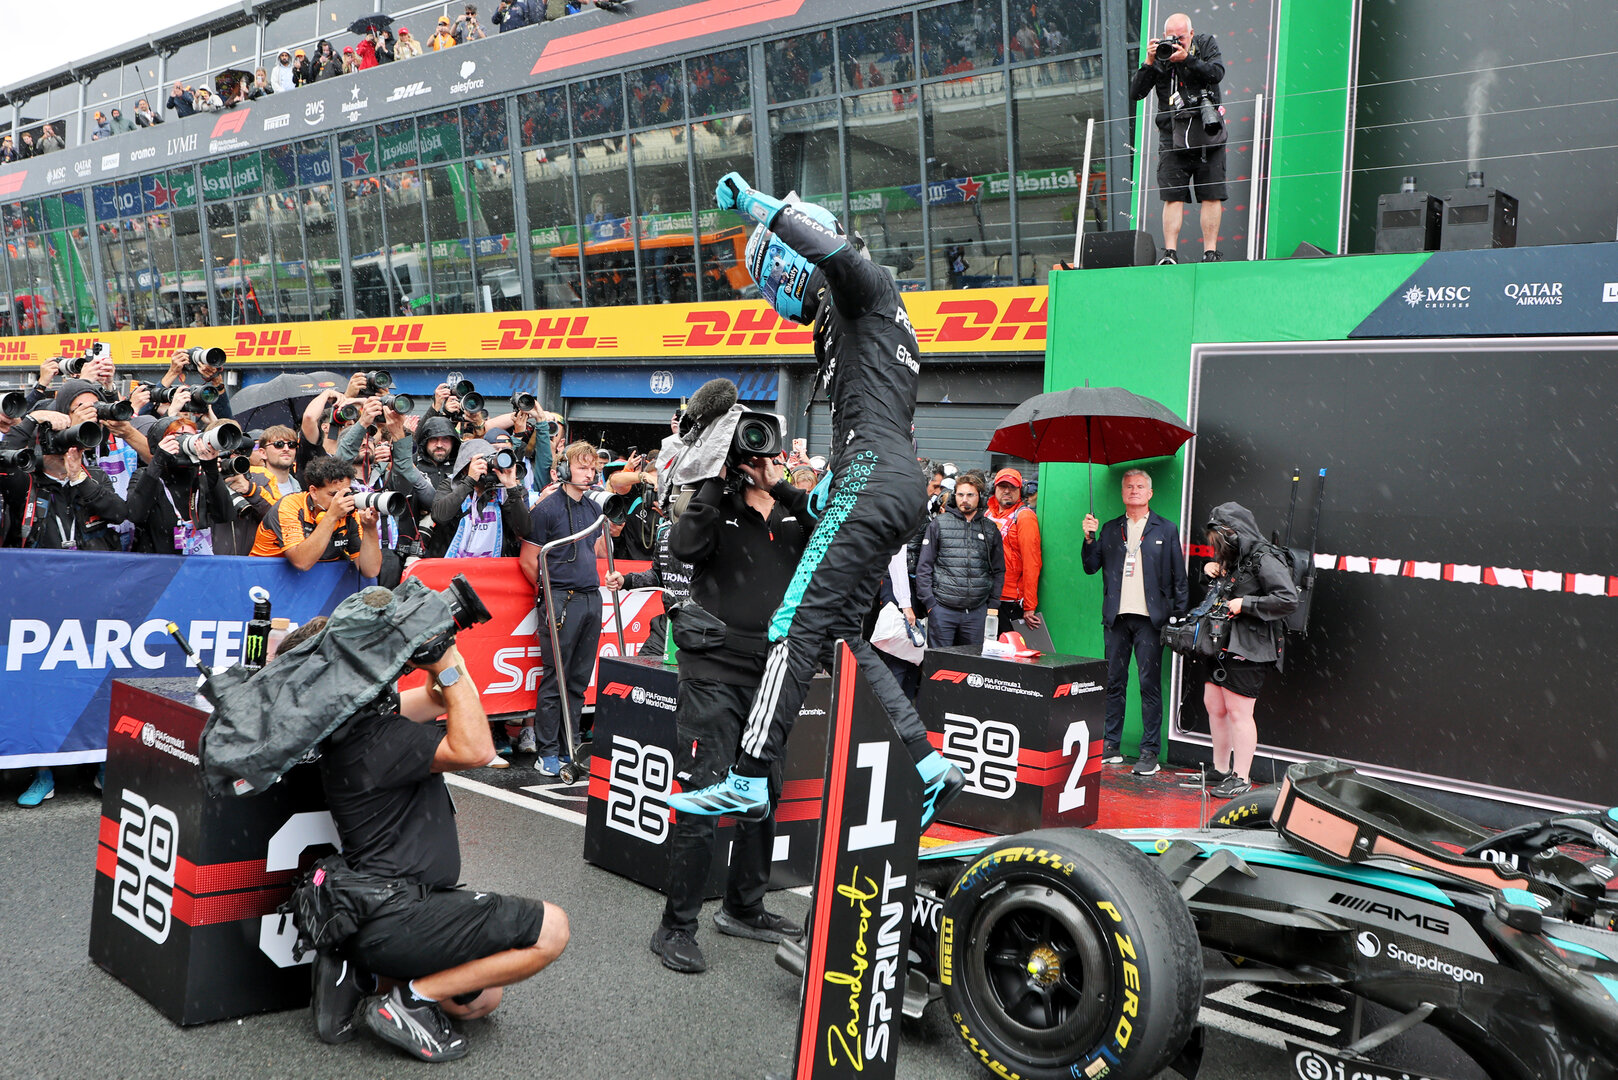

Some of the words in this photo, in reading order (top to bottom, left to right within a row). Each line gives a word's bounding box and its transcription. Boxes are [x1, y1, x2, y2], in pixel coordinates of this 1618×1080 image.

[450, 79, 484, 94] salesforce
[304, 100, 325, 117] aws
[130, 146, 156, 161] aramco
[167, 133, 198, 156] LVMH
[52, 166, 67, 180] MSC
[793, 212, 824, 232] Meta
[1426, 286, 1471, 302] MSC
[1504, 282, 1563, 298] QATAR
[1516, 296, 1563, 307] AIRWAYS
[684, 308, 815, 347] DHL
[934, 296, 1048, 343] DH
[235, 329, 298, 357] DHL
[350, 323, 431, 354] DHL
[497, 316, 598, 350] DHL
[651, 371, 674, 393] FIA
[5, 618, 169, 671] PARC
[984, 677, 994, 685] FIA
[994, 678, 1017, 688] Formula
[984, 683, 1000, 691] World
[1000, 685, 1042, 697] Championship
[646, 698, 660, 707] World
[659, 702, 677, 712] Champ
[654, 693, 674, 704] Formula
[799, 708, 823, 717] pionship
[155, 740, 169, 752] World
[1057, 719, 1090, 814] 2
[733, 778, 751, 792] 63
[847, 740, 898, 852] 1
[1364, 901, 1450, 936] AMG
[864, 859, 907, 1064] SPRINT
[939, 915, 954, 986] PIRELLI
[823, 864, 879, 1072] Zandvoort
[1096, 900, 1123, 923] P
[1114, 931, 1141, 1050] ZERO
[1386, 942, 1485, 986] Snapdragon
